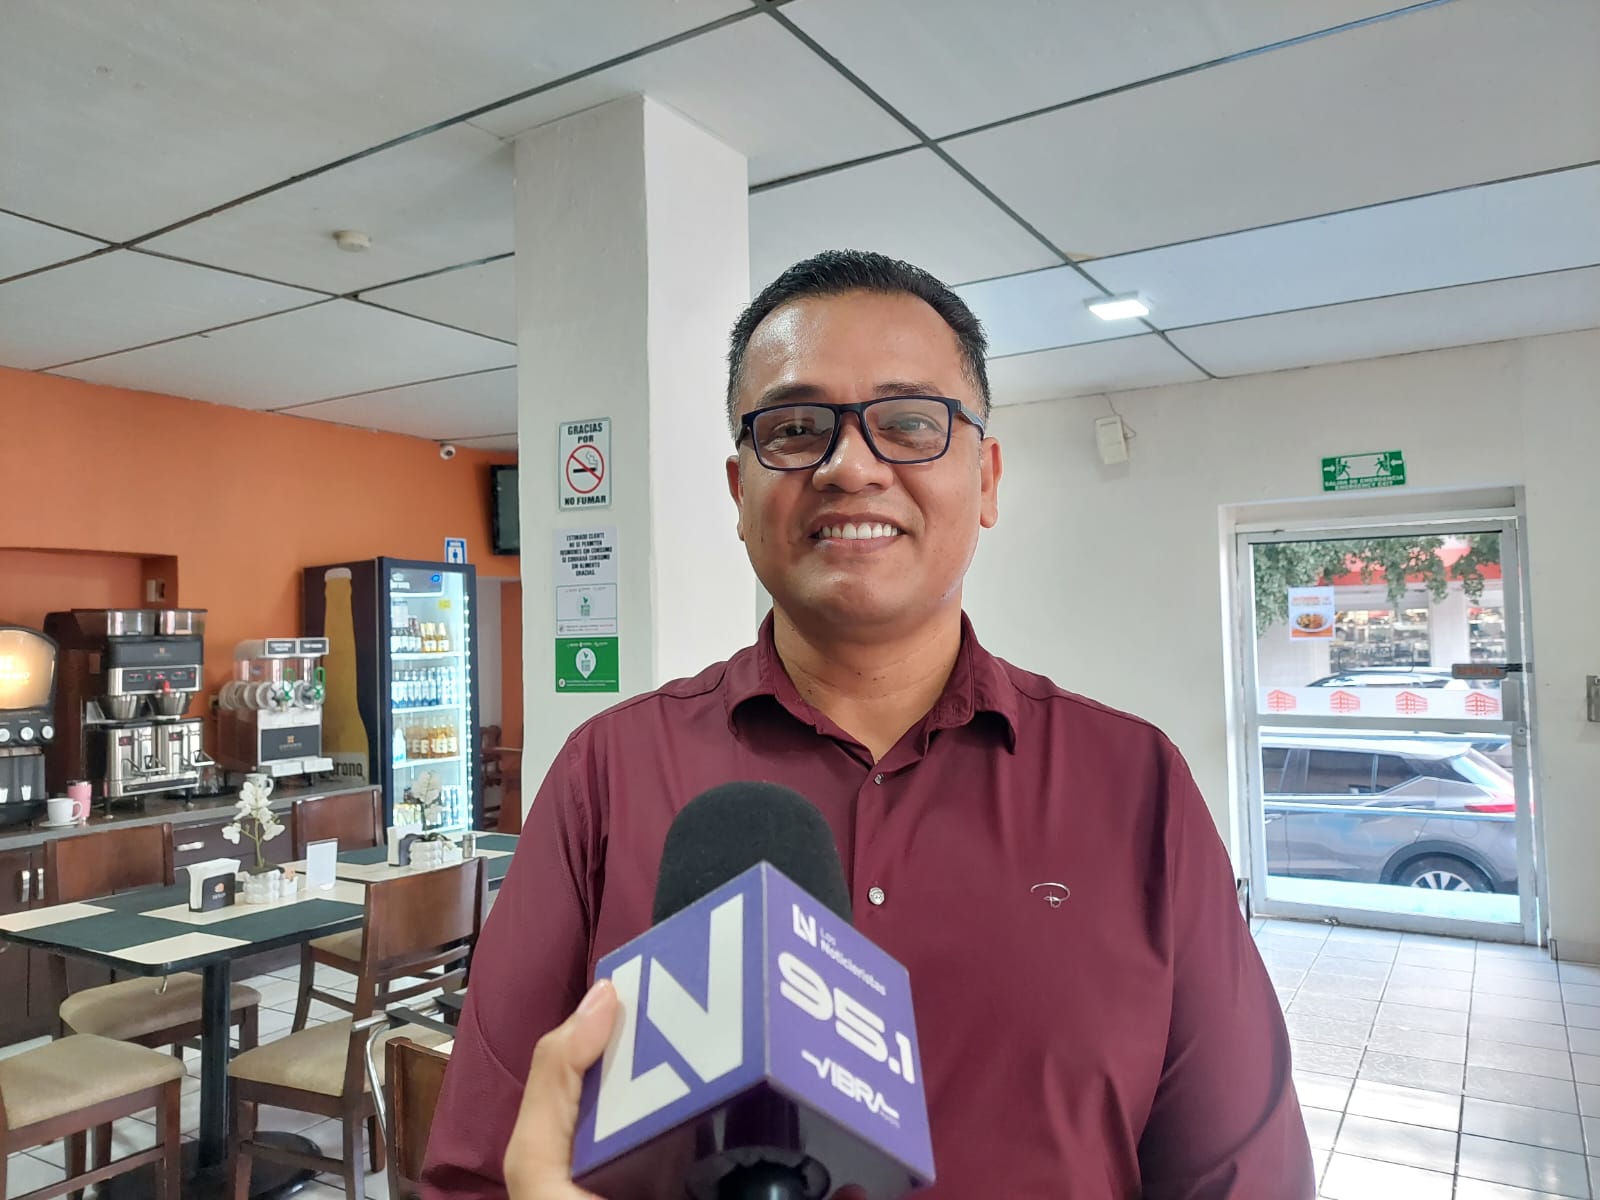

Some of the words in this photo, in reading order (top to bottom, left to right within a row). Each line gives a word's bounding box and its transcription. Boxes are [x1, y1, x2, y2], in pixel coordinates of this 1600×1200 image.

[568, 422, 603, 435] GRACIAS
[577, 435, 594, 444] POR
[564, 497, 575, 505] NO
[576, 495, 606, 505] FUMAR
[778, 951, 915, 1085] 95.1
[801, 1049, 900, 1120] VIBRA
